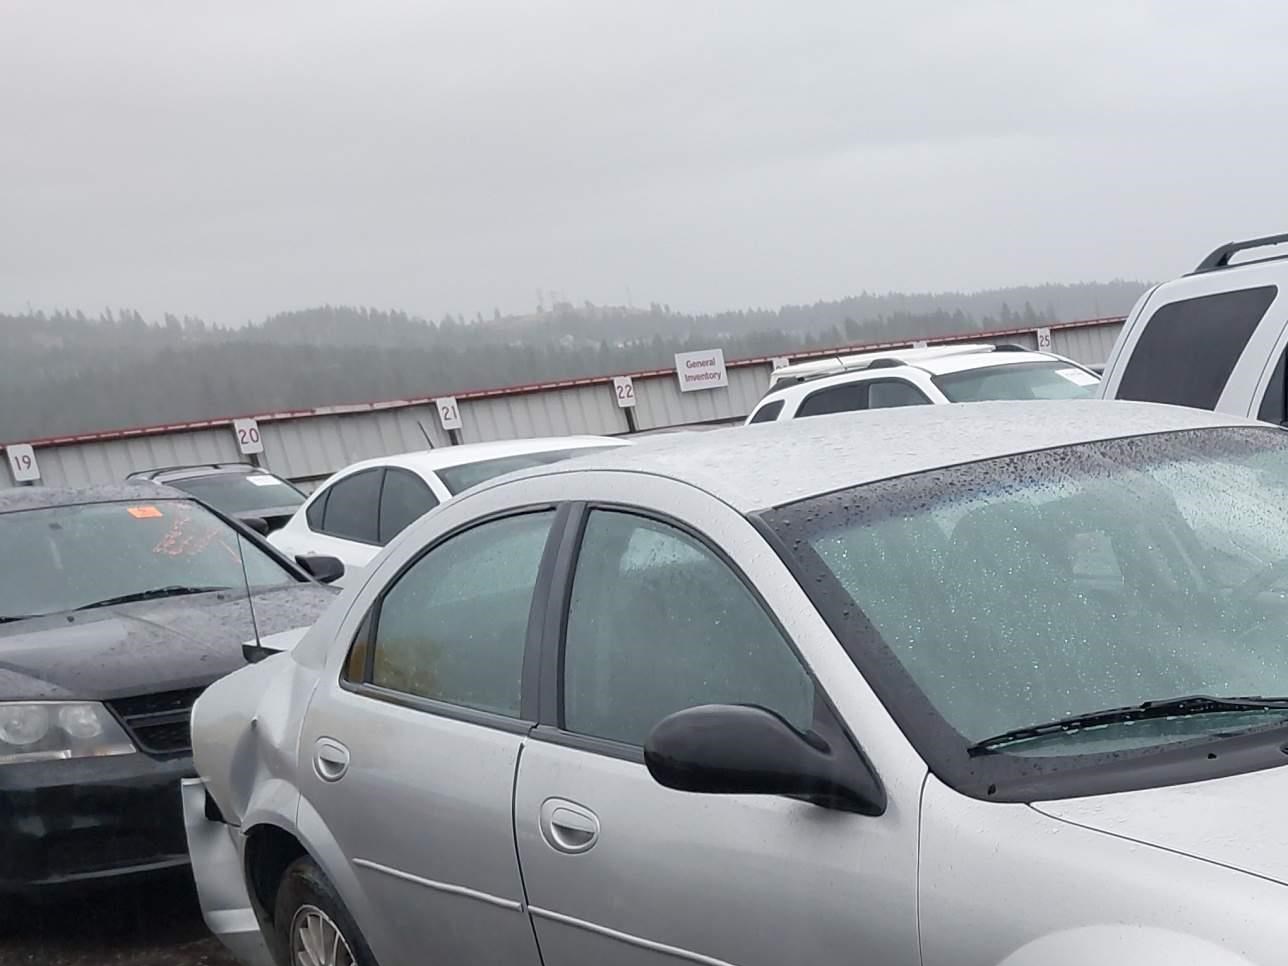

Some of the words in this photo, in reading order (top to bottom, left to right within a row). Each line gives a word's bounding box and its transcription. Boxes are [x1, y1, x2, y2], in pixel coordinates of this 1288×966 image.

[1039, 334, 1050, 347] 25
[686, 357, 716, 369] General
[684, 370, 722, 383] Inventory
[616, 384, 634, 399] 22
[441, 404, 458, 420] 21
[238, 427, 260, 445] 20
[14, 454, 32, 470] 19
